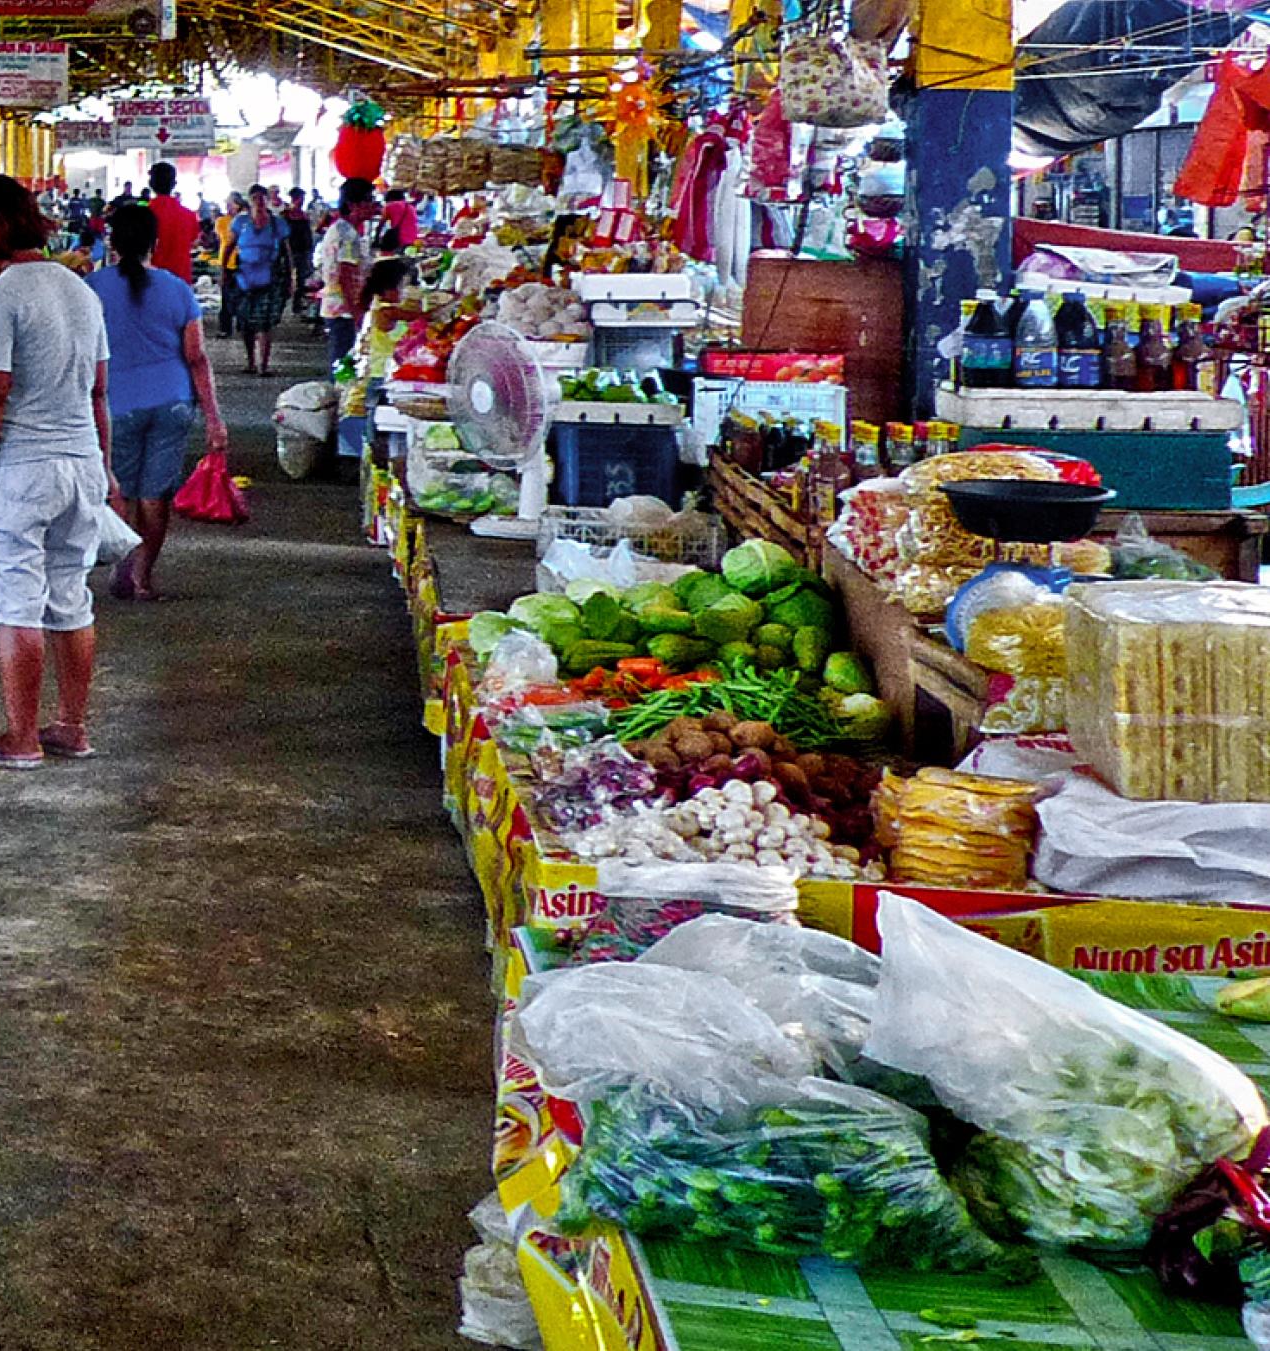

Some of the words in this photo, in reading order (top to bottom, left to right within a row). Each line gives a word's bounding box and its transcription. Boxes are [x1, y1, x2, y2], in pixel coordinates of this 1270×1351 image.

[114, 100, 165, 116] FARMERS
[1073, 944, 1160, 973] Nuot
[1162, 944, 1205, 972] sa
